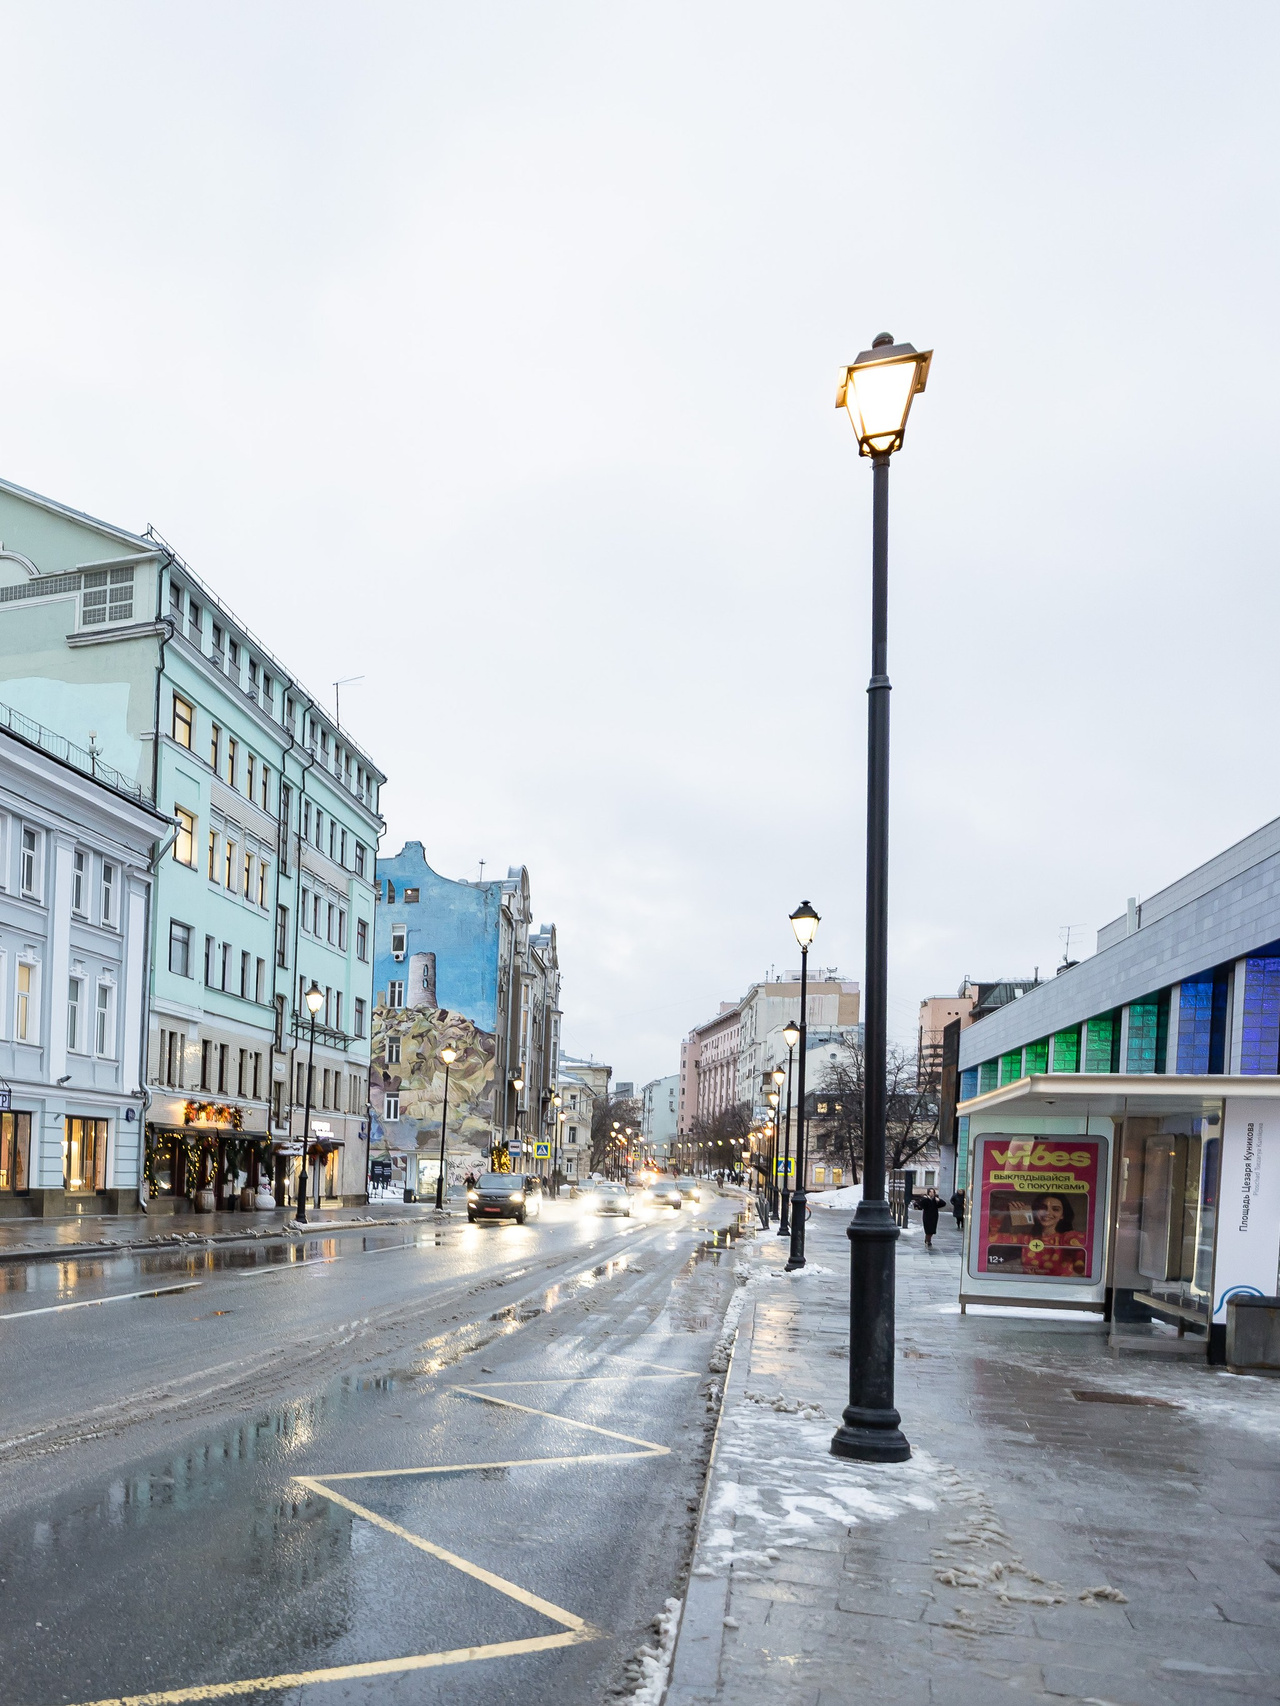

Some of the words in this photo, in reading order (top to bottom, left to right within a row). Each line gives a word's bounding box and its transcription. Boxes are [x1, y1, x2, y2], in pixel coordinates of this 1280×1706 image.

[1243, 1122, 1255, 1161] Куникова
[991, 1144, 1091, 1167] wibes
[993, 1173, 1071, 1182] выкладывайся
[1027, 1182, 1085, 1191] покупками
[1241, 1163, 1253, 1193] Цезаря
[1239, 1194, 1251, 1232] Площадь
[988, 1255, 1004, 1263] 12+
